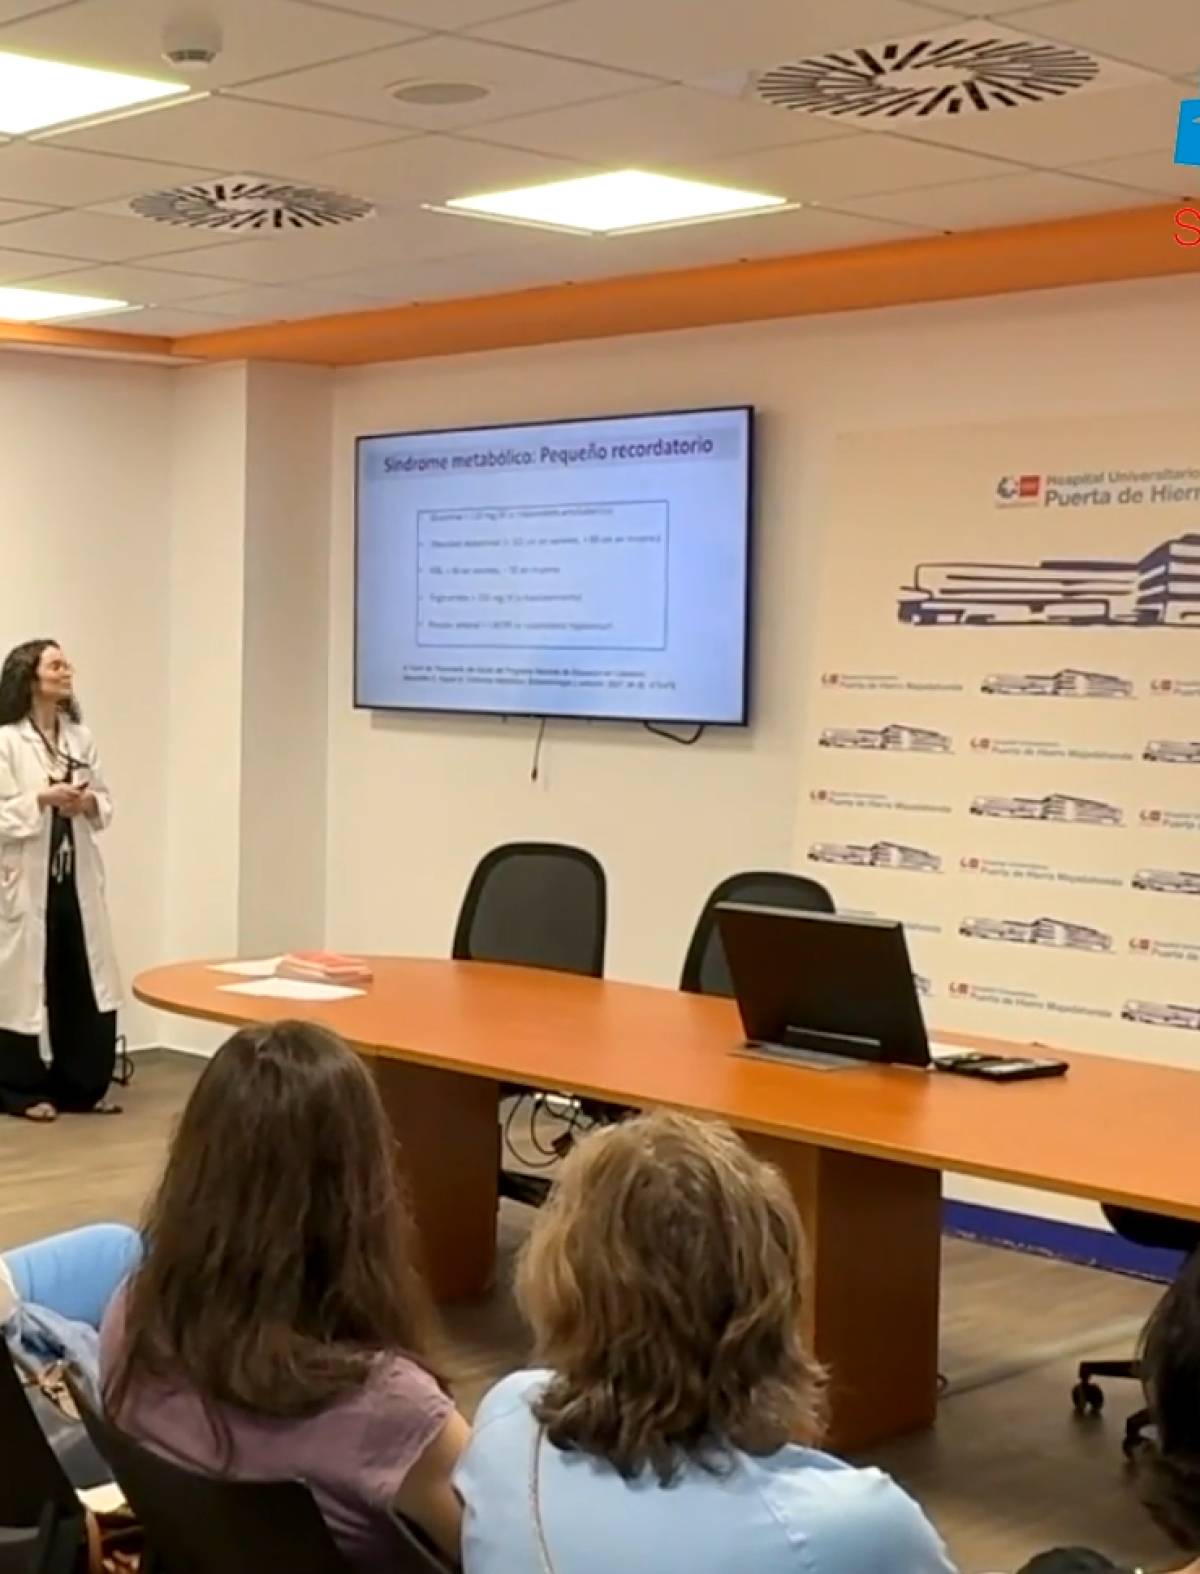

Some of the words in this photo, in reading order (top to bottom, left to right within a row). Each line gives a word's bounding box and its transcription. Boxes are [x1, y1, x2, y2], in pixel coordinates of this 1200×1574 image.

[540, 442, 608, 467] Pequeño
[611, 435, 714, 457] recordatorio
[1044, 488, 1110, 507] Puerta
[1118, 486, 1143, 505] de
